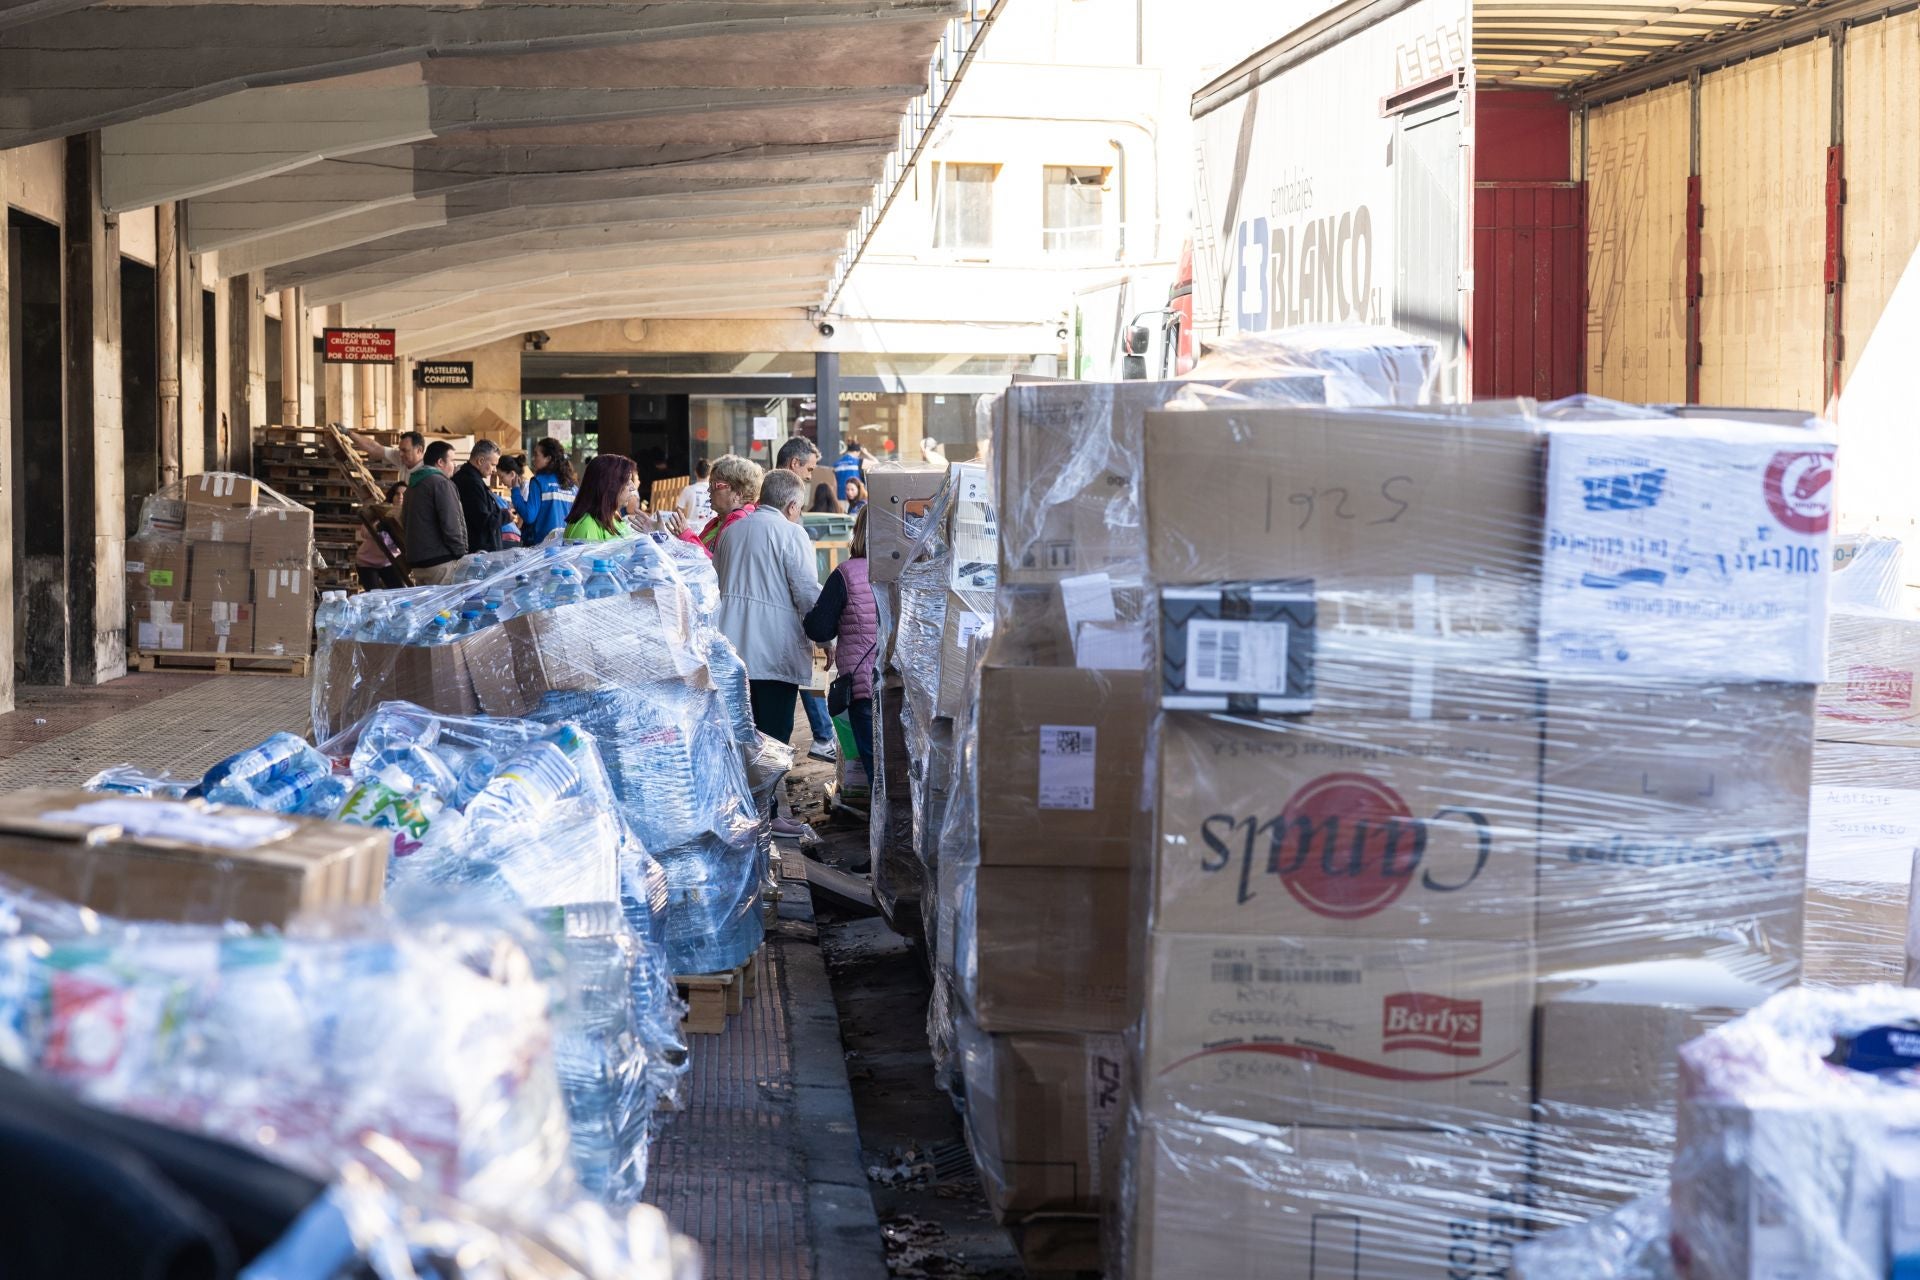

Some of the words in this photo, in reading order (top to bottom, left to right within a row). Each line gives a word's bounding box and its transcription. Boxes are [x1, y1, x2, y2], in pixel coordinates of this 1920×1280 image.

[1271, 165, 1313, 222] embalajes
[1271, 205, 1372, 330] BLANCO
[424, 366, 467, 374] PASTELERIA
[424, 376, 469, 384] CONFITERIA
[1201, 810, 1492, 905] Canals
[1387, 1005, 1478, 1041] Berlys
